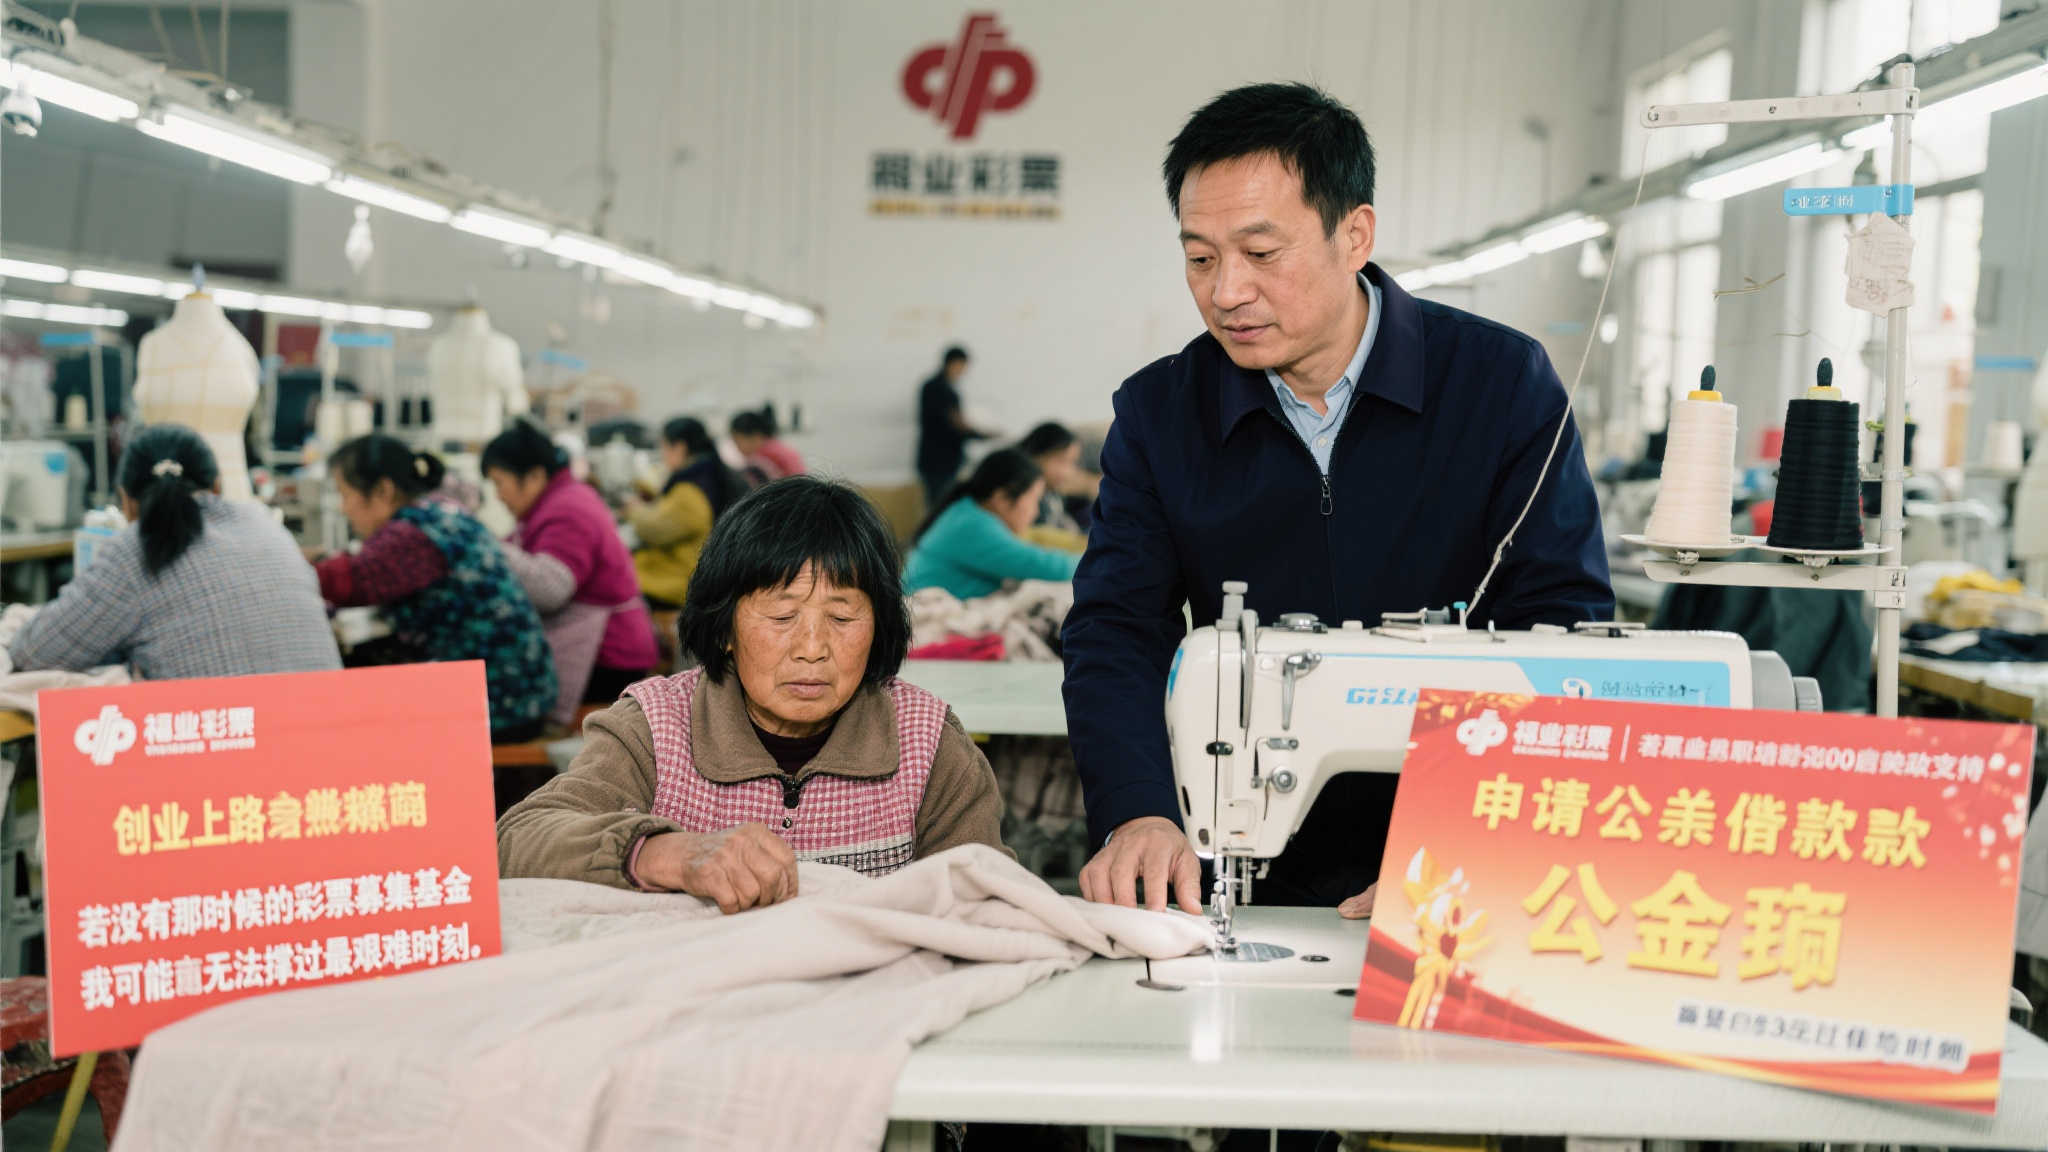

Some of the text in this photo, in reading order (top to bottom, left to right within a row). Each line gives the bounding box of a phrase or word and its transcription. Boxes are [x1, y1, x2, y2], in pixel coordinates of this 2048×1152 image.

[77, 865, 472, 948] 若没有那时候的彩票募集基金
